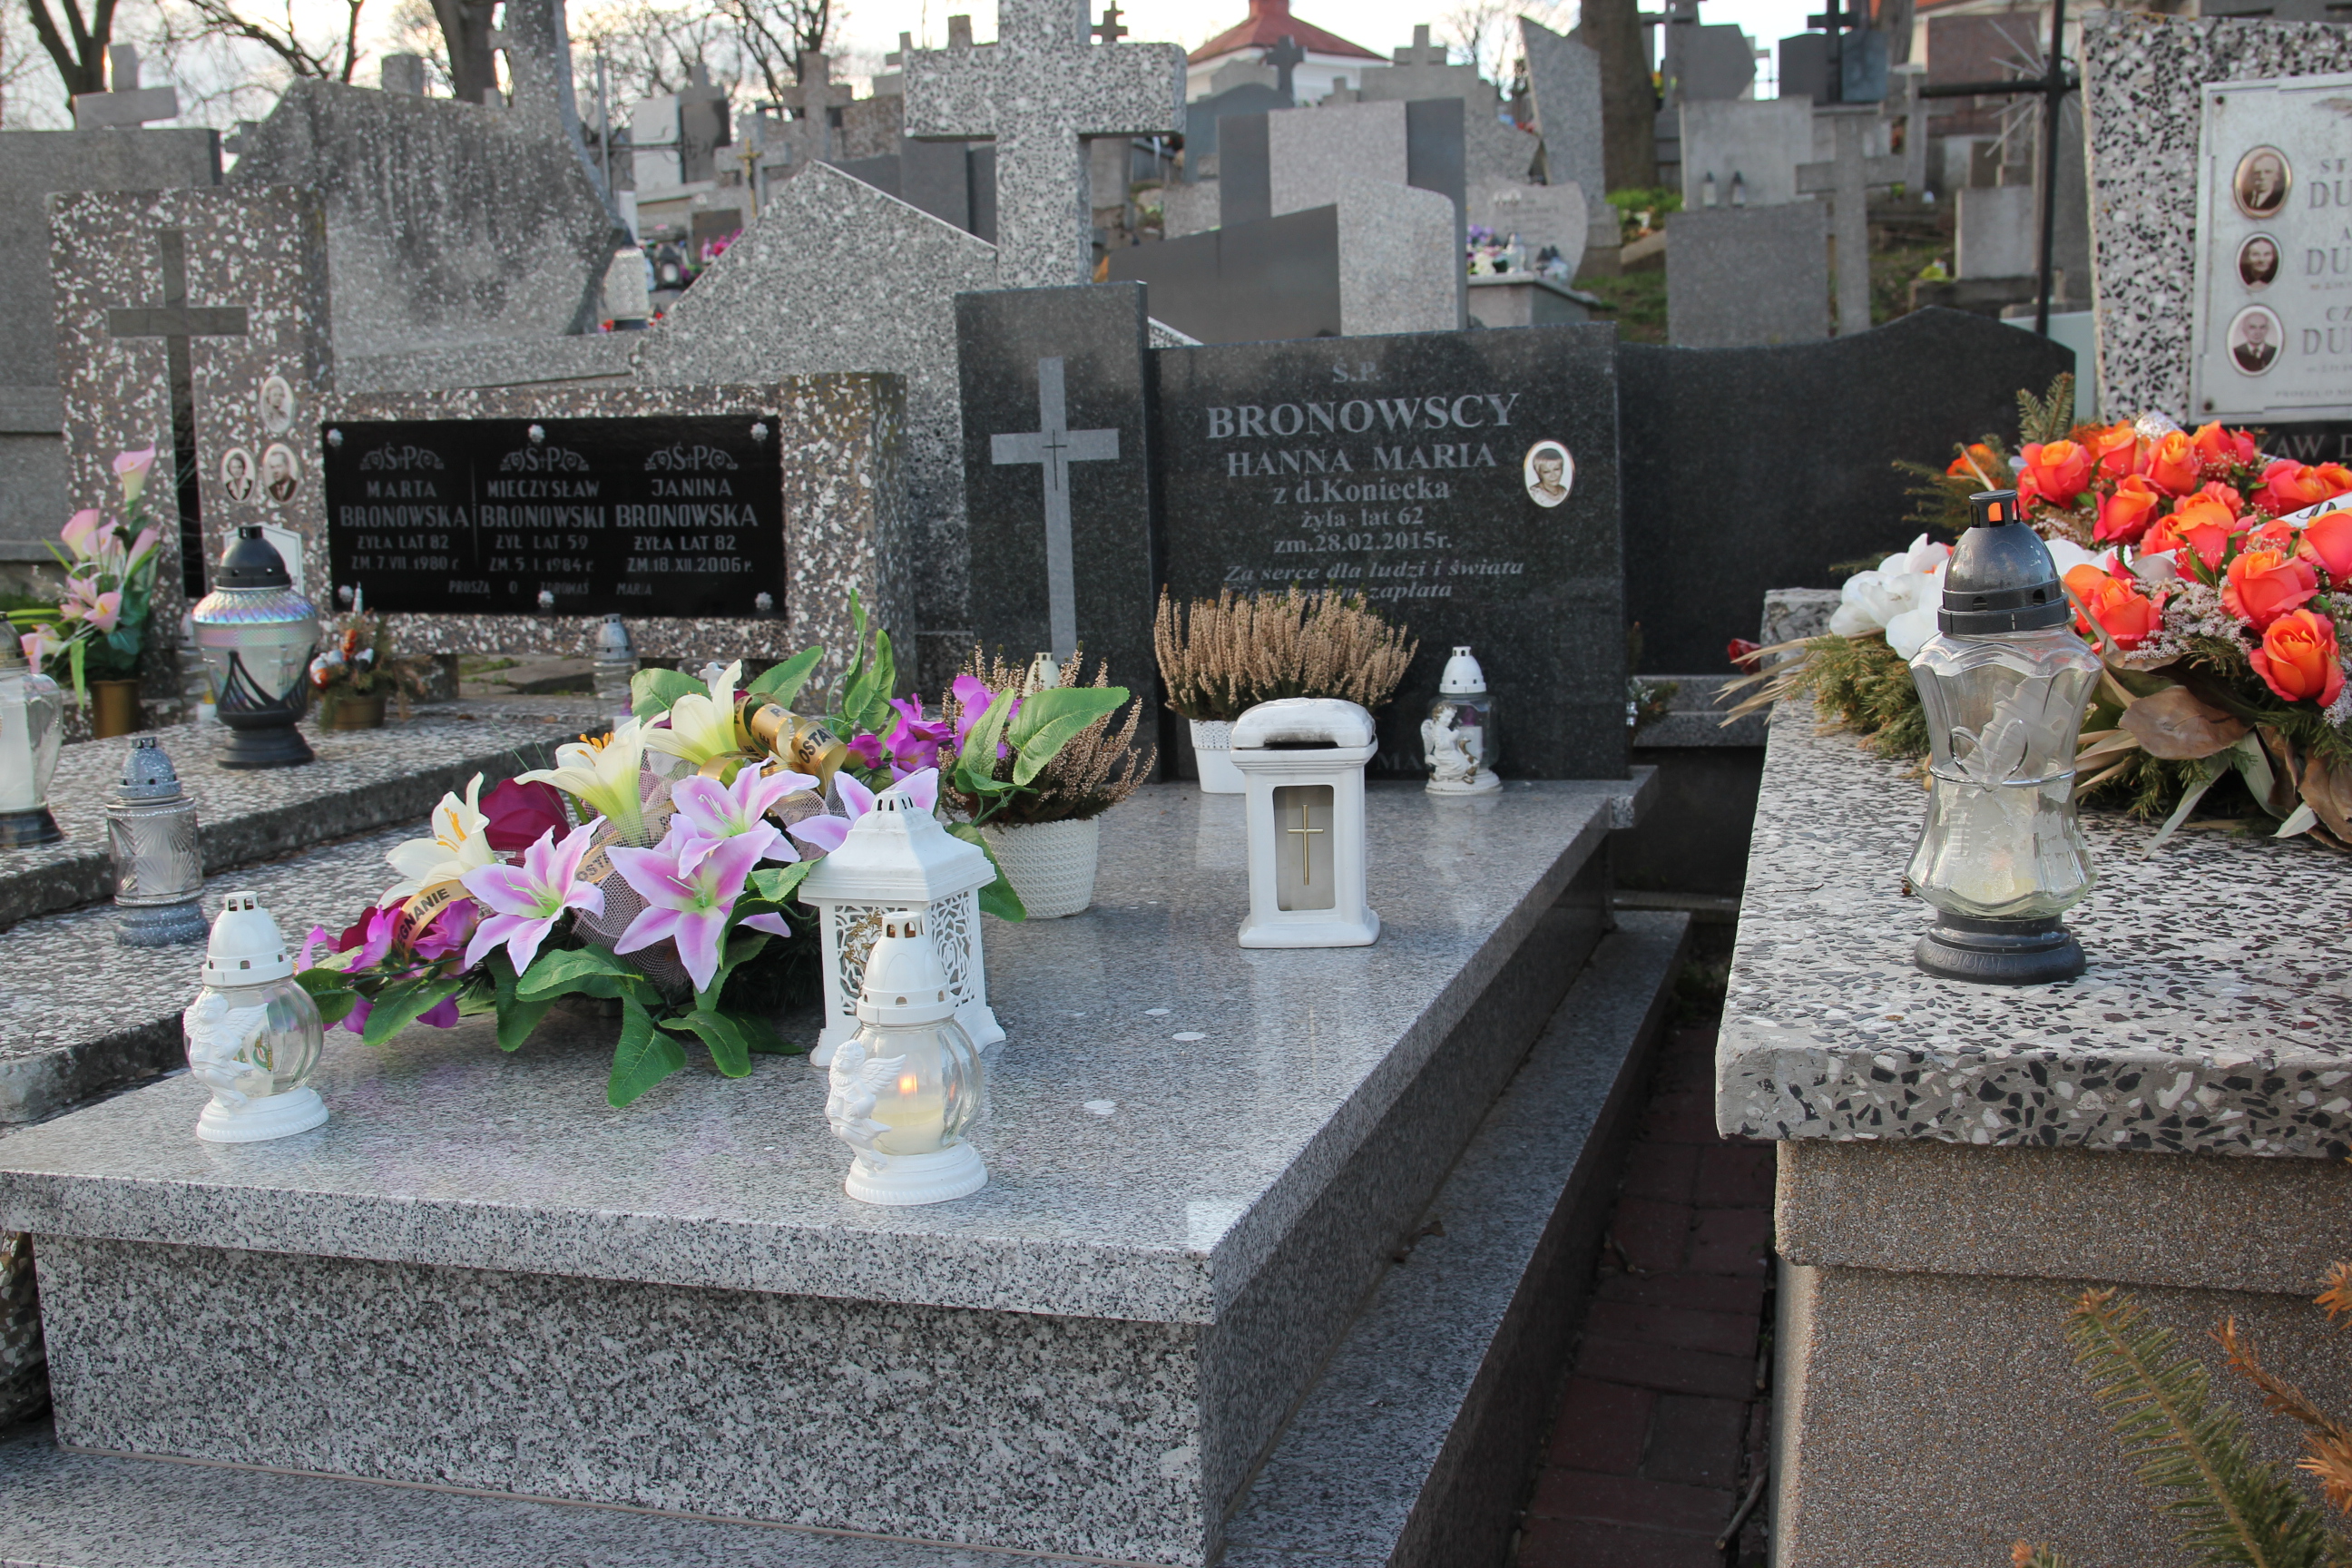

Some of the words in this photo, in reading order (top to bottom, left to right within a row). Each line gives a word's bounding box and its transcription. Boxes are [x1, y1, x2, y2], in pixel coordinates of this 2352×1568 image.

[1206, 393, 1520, 439] BRONOWSCY
[1228, 448, 1355, 477] HANNA
[1372, 443, 1497, 472] MARIA
[367, 480, 436, 498] MARTA
[487, 479, 600, 498] MIECZYSŁAW
[652, 478, 732, 497] JANINA
[1273, 487, 1288, 505] z
[339, 505, 470, 527] BRONOWSKA
[481, 505, 605, 529] BRONOWSKI
[615, 504, 759, 528] BRONOWSKA
[1301, 510, 1347, 533] żyła
[1361, 508, 1390, 526] lat
[1398, 505, 1425, 525] 62
[399, 534, 424, 550] LAT
[429, 534, 450, 550] 82
[534, 534, 560, 550] LAT
[567, 534, 589, 550] 59
[681, 535, 710, 551] LAT
[715, 534, 737, 551] 82
[1224, 565, 1253, 582] Za
[1261, 567, 1319, 581] serce
[1327, 562, 1362, 579] dla
[1368, 561, 1426, 578] ludzi
[1432, 559, 1442, 576] i
[1448, 559, 1524, 576] świata
[1368, 581, 1452, 603] zapłata
